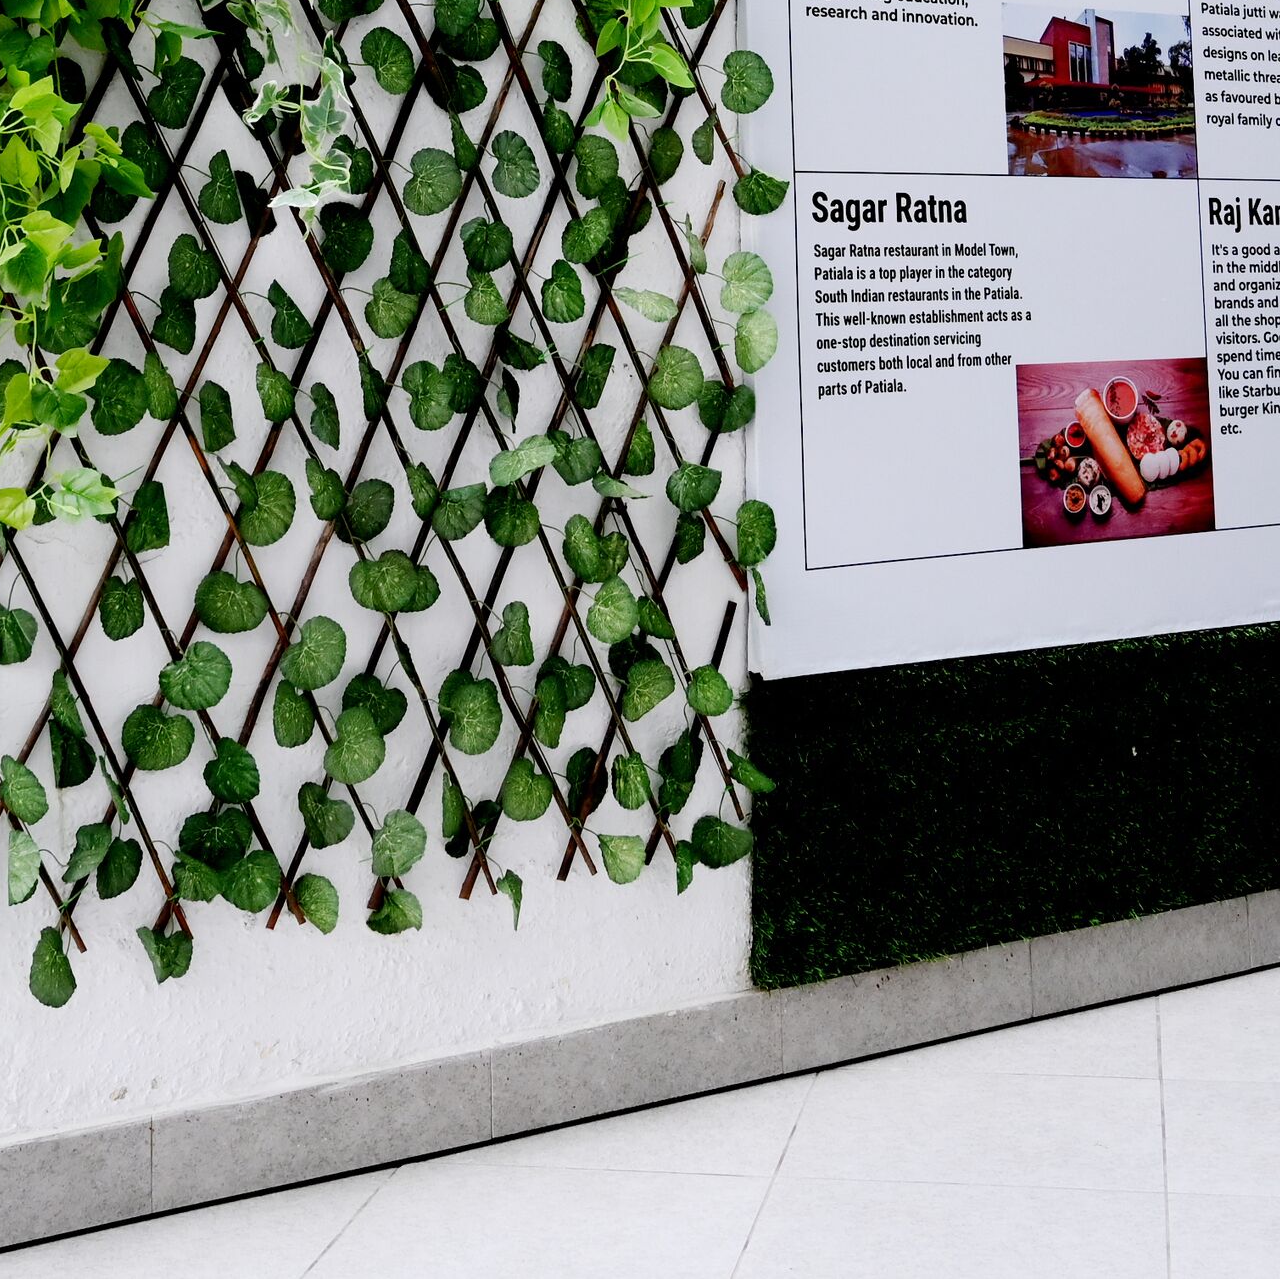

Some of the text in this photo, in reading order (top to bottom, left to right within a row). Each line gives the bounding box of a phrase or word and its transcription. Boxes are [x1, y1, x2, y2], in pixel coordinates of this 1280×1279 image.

[806, 6, 978, 27] research and innovation.
[1204, 69, 1250, 82] metallic
[811, 191, 967, 231] Sagar Ratna
[1208, 197, 1241, 233] Raj
[814, 243, 1018, 261] Sagar Ratna restaurant in Model Town,
[1218, 385, 1239, 399] like
